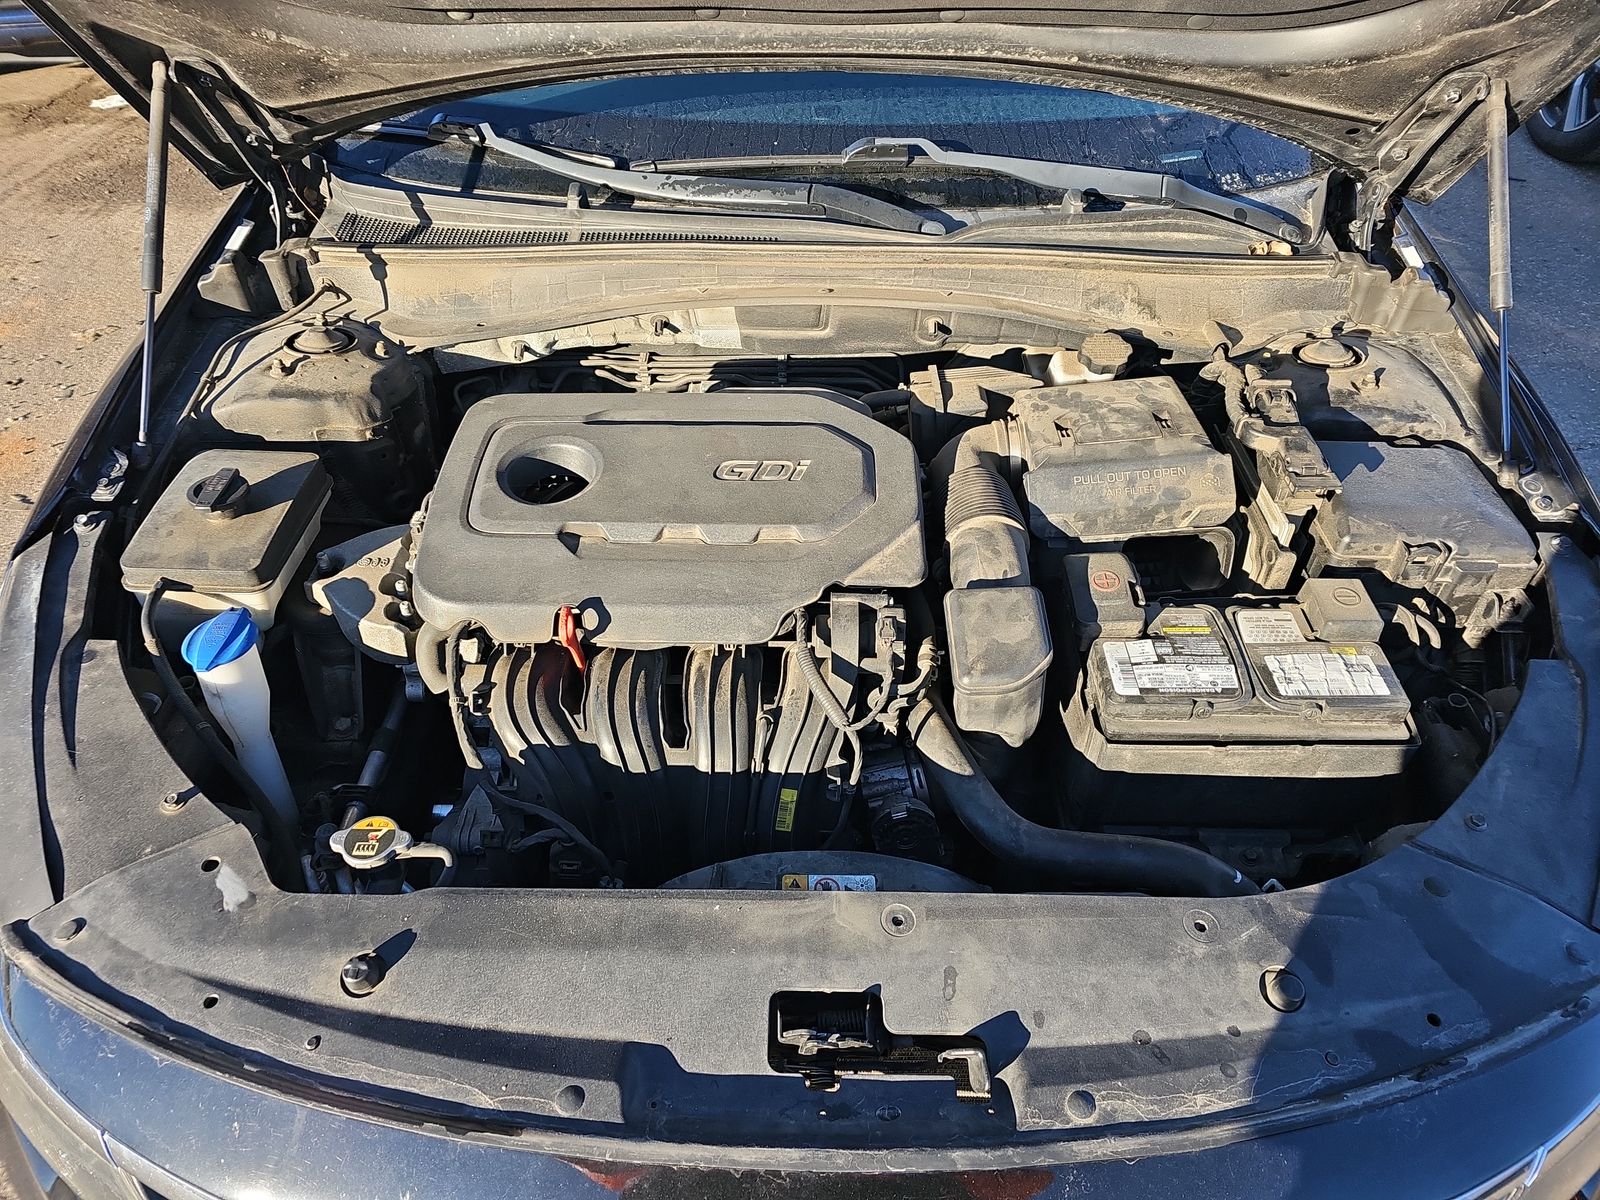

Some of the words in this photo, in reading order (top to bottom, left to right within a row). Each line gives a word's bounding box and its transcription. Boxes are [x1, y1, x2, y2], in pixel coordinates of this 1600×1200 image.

[714, 460, 811, 481] GDi
[1073, 474, 1104, 486] PULL
[1107, 471, 1132, 483] OUT
[1134, 469, 1150, 481] TO
[1153, 466, 1187, 479] OPEN
[1105, 488, 1122, 498] AIR
[1125, 485, 1157, 496] FILTER
